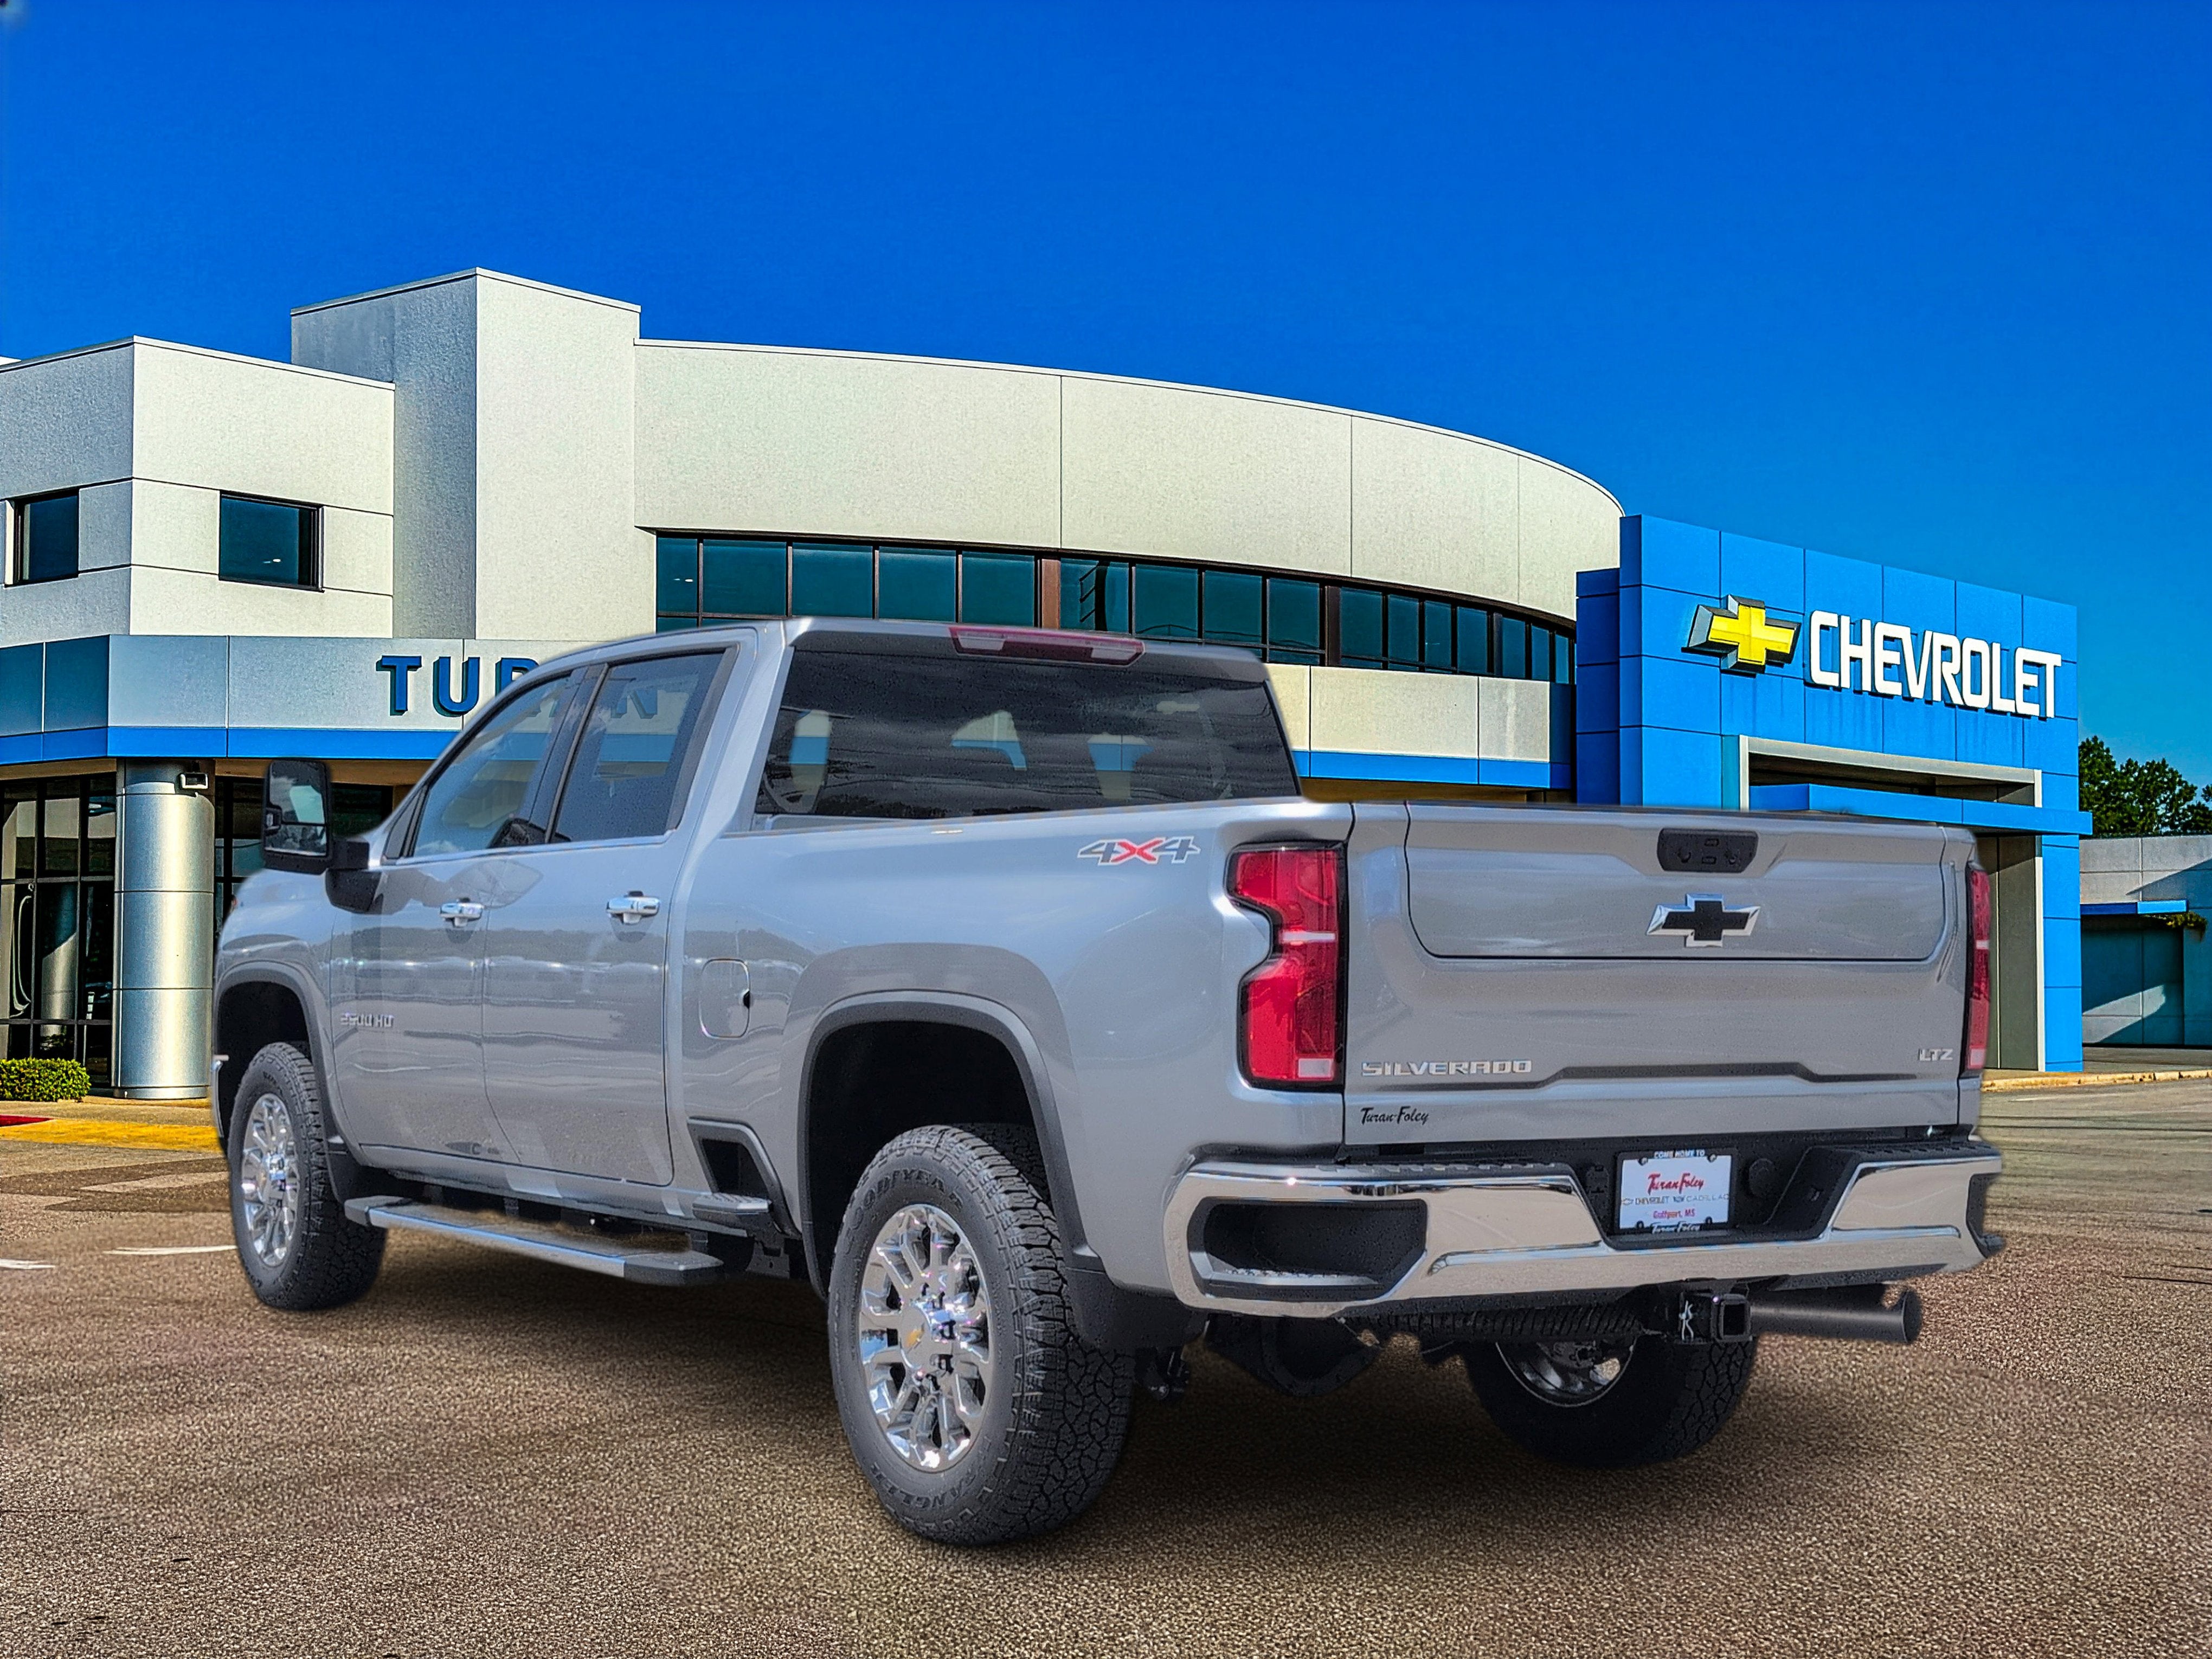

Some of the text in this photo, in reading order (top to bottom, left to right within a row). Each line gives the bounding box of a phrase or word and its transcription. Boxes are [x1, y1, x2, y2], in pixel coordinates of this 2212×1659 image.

[1809, 609, 2062, 719] CHEVROLET
[1918, 1048, 1953, 1061] LTZ
[1361, 1059, 1532, 1077] SILVERADO
[1696, 1149, 1705, 1157] TO
[1684, 1208, 1695, 1217] MS
